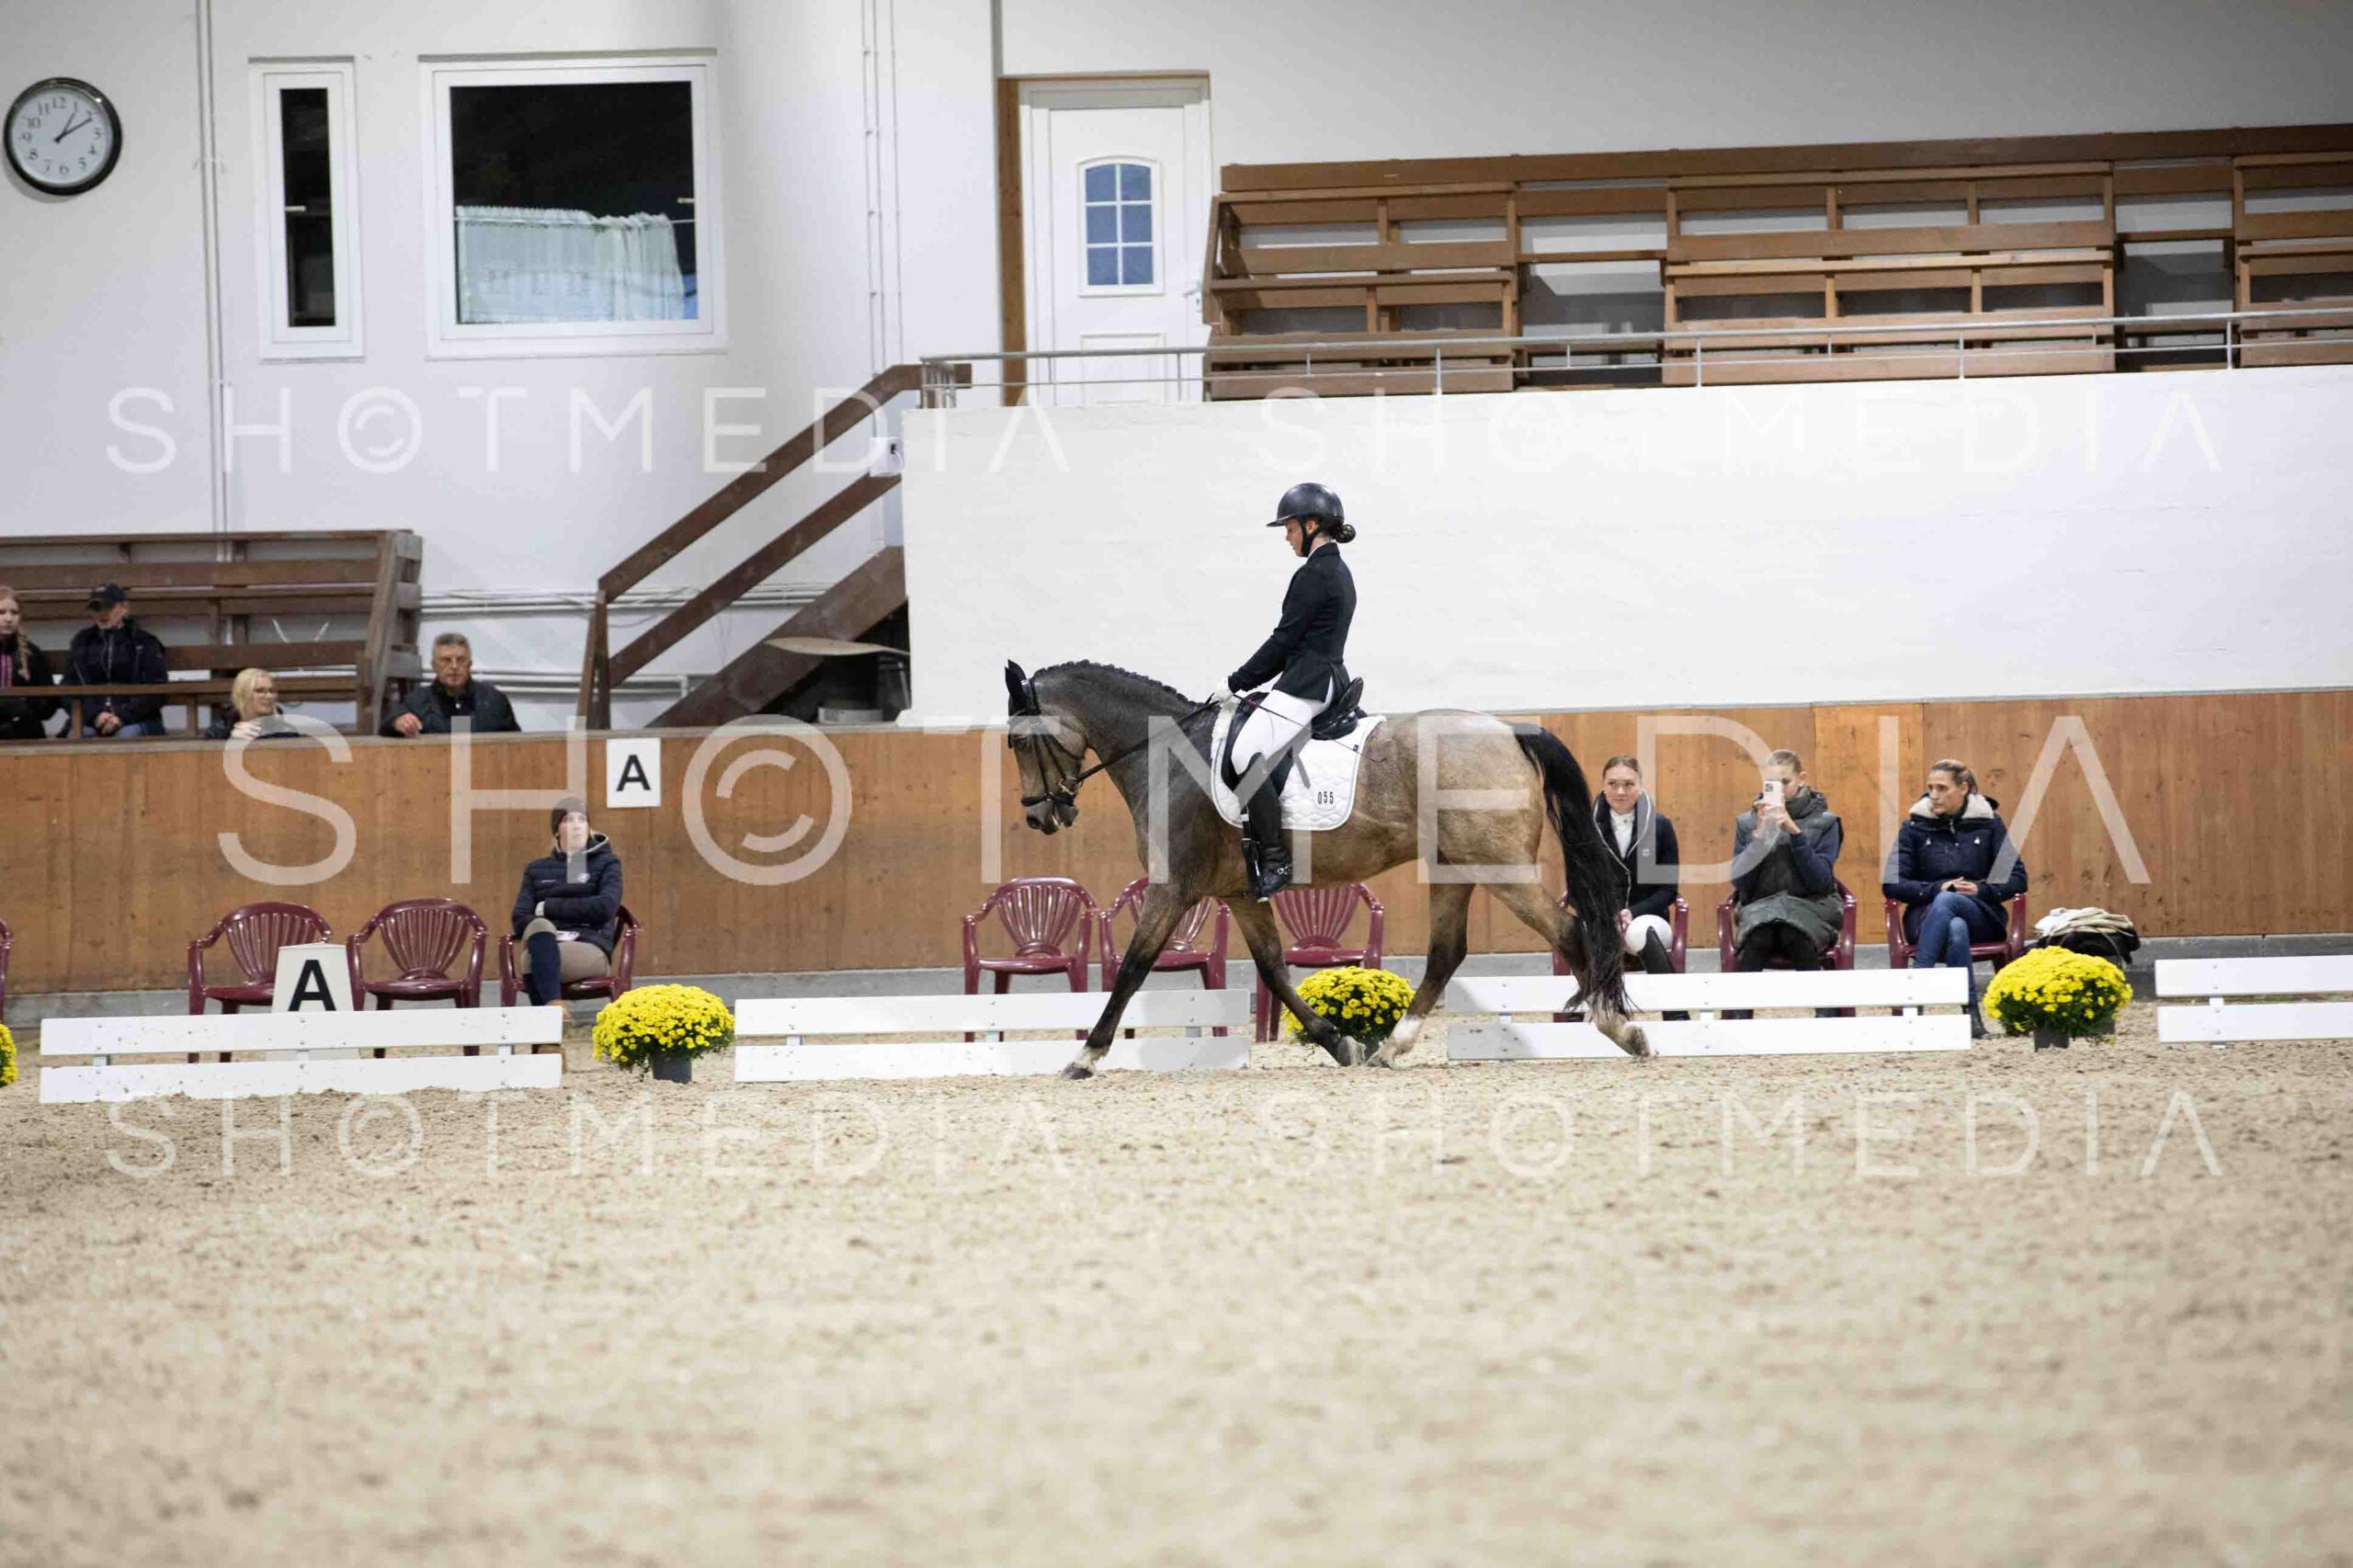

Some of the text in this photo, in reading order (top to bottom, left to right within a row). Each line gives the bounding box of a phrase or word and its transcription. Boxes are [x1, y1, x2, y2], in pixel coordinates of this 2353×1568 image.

[52, 97, 66, 109] 12
[38, 103, 51, 116] 11
[27, 117, 41, 129] 10
[21, 131, 31, 142] 9
[94, 128, 102, 139] 3
[28, 149, 39, 160] 8
[87, 145, 97, 155] 4
[44, 159, 53, 172] 7
[77, 157, 87, 170] 5
[59, 164, 69, 176] 6
[616, 754, 652, 791] A
[1317, 791, 1335, 804] 055
[288, 960, 336, 1011] A
